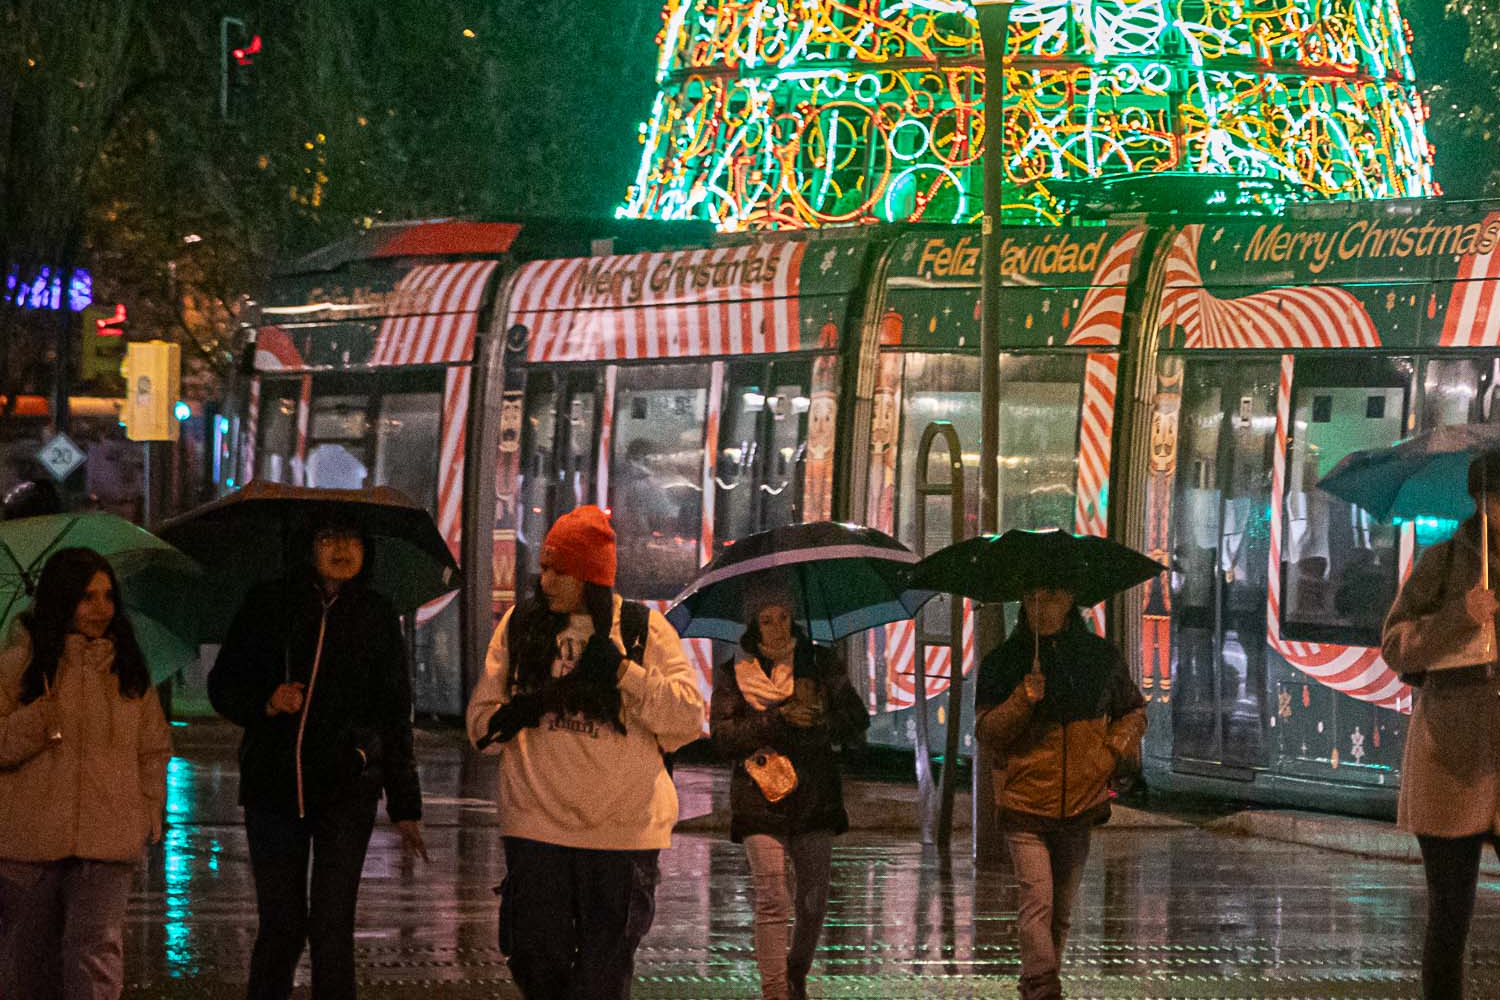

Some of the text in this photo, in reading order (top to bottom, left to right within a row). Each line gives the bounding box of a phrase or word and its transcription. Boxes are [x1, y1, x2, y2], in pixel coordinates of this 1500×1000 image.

[917, 236, 980, 275] Feliz
[1245, 222, 1339, 273] Merry
[576, 257, 780, 304] Merry Christmas
